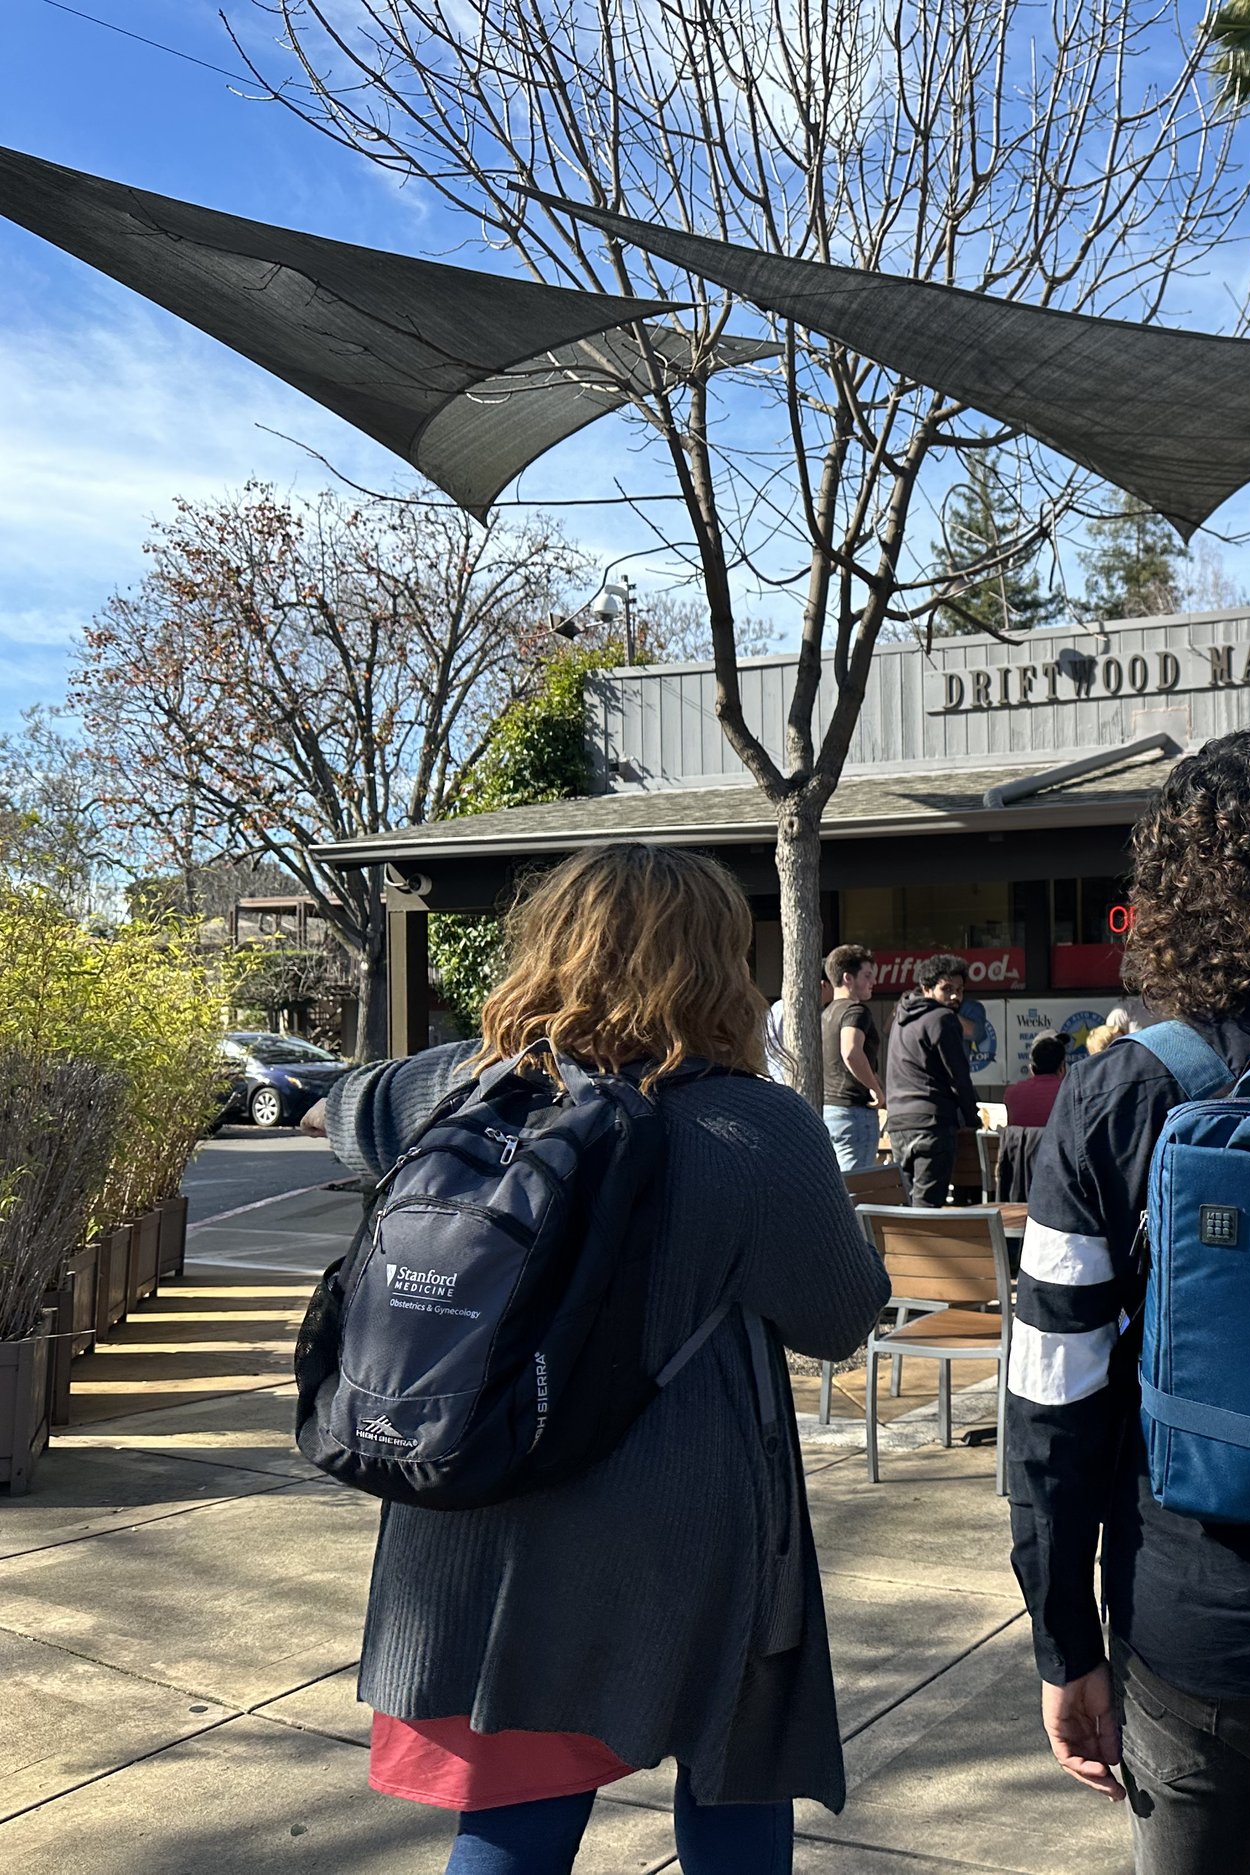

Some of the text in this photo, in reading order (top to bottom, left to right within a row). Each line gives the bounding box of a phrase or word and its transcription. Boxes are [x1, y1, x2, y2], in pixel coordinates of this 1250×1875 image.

[943, 652, 1179, 709] DRIFTWOOD
[1016, 1014, 1052, 1031] Weekly
[397, 1266, 458, 1287] Stanford
[394, 1281, 454, 1297] MEDICINE
[390, 1298, 481, 1319] Obstetrics & Gynecology
[356, 1429, 378, 1441] HIGH
